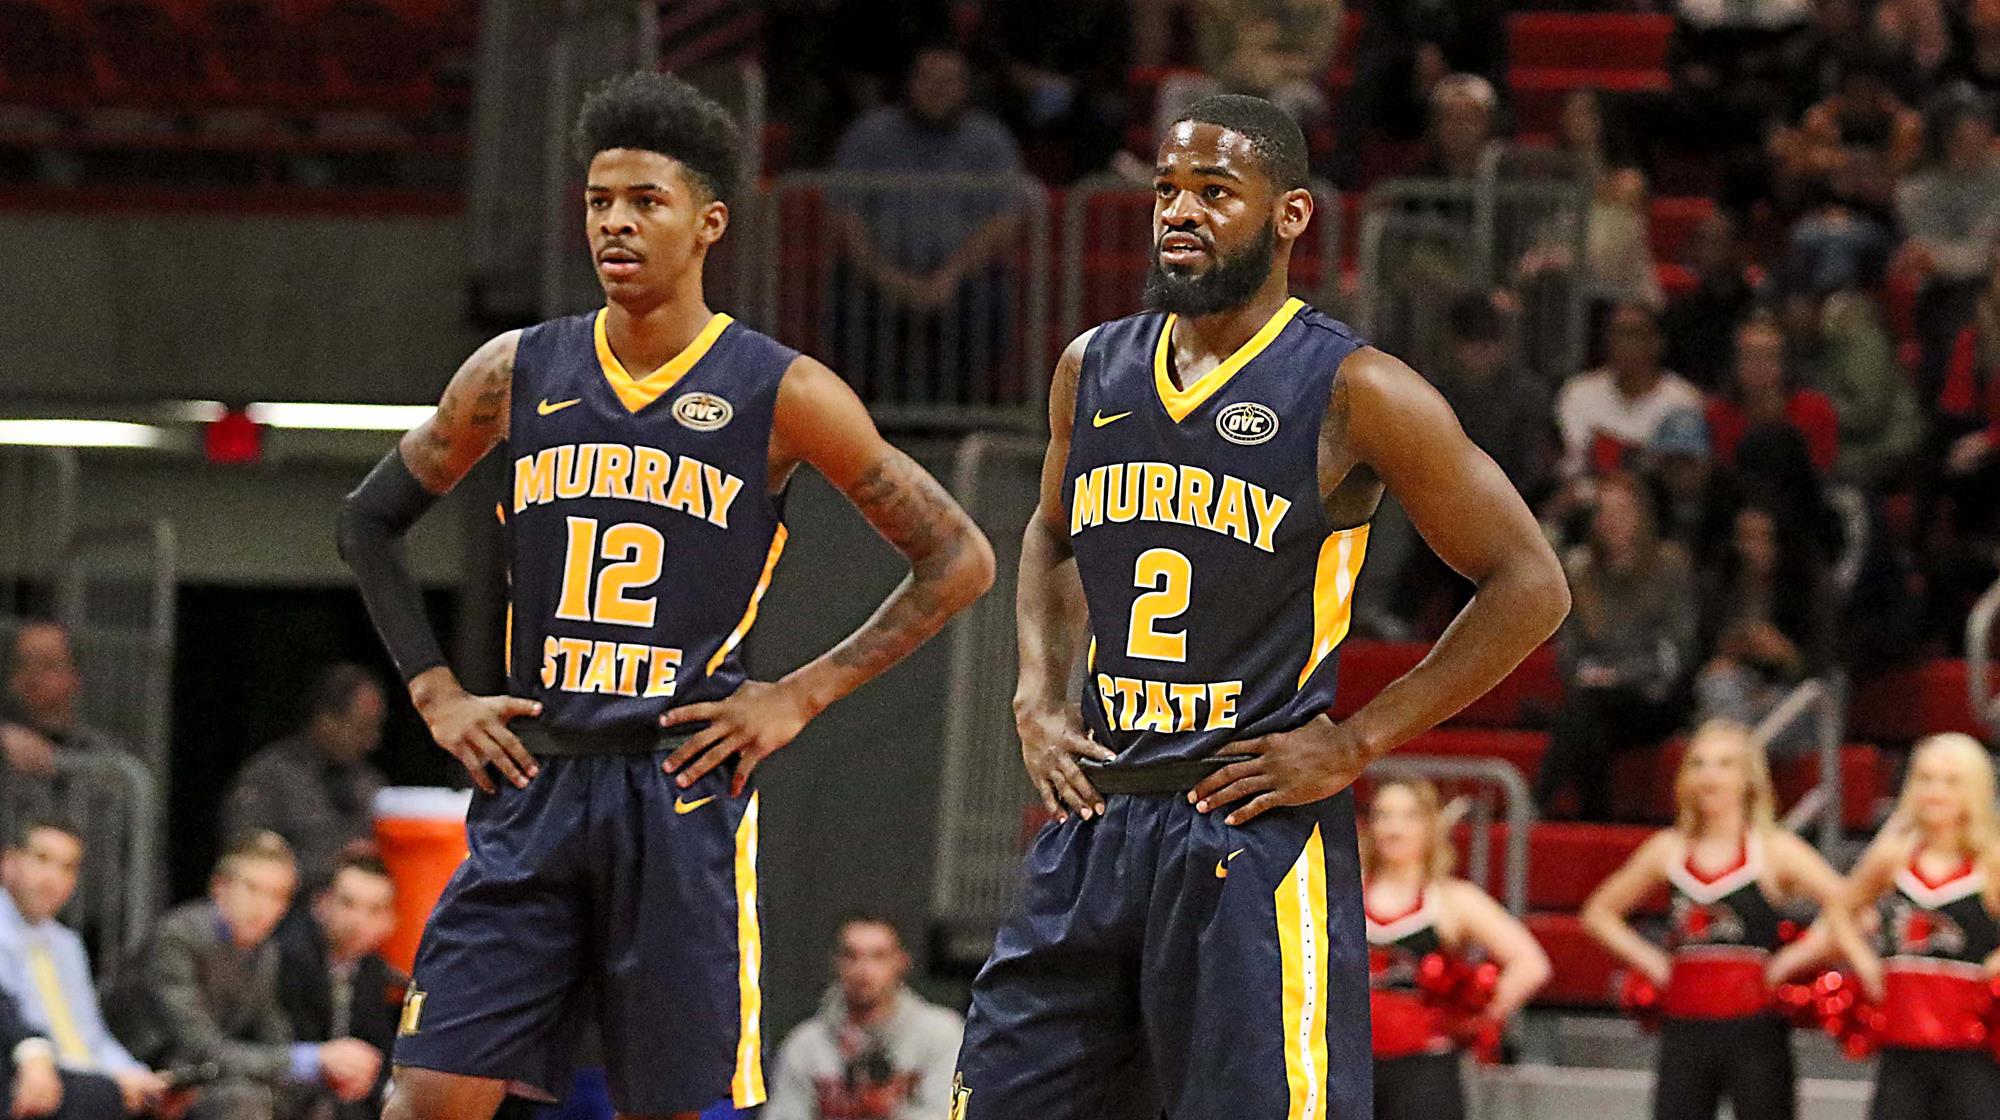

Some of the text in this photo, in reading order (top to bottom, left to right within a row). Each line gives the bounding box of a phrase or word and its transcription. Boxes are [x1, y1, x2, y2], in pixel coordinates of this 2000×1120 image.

[685, 403, 720, 421] OVC
[1229, 414, 1265, 433] OVC
[513, 443, 744, 529] MURRAY
[1070, 461, 1293, 553] MURRAY
[554, 515, 666, 628] 12
[1125, 547, 1193, 663] 2
[540, 635, 683, 698] STATE
